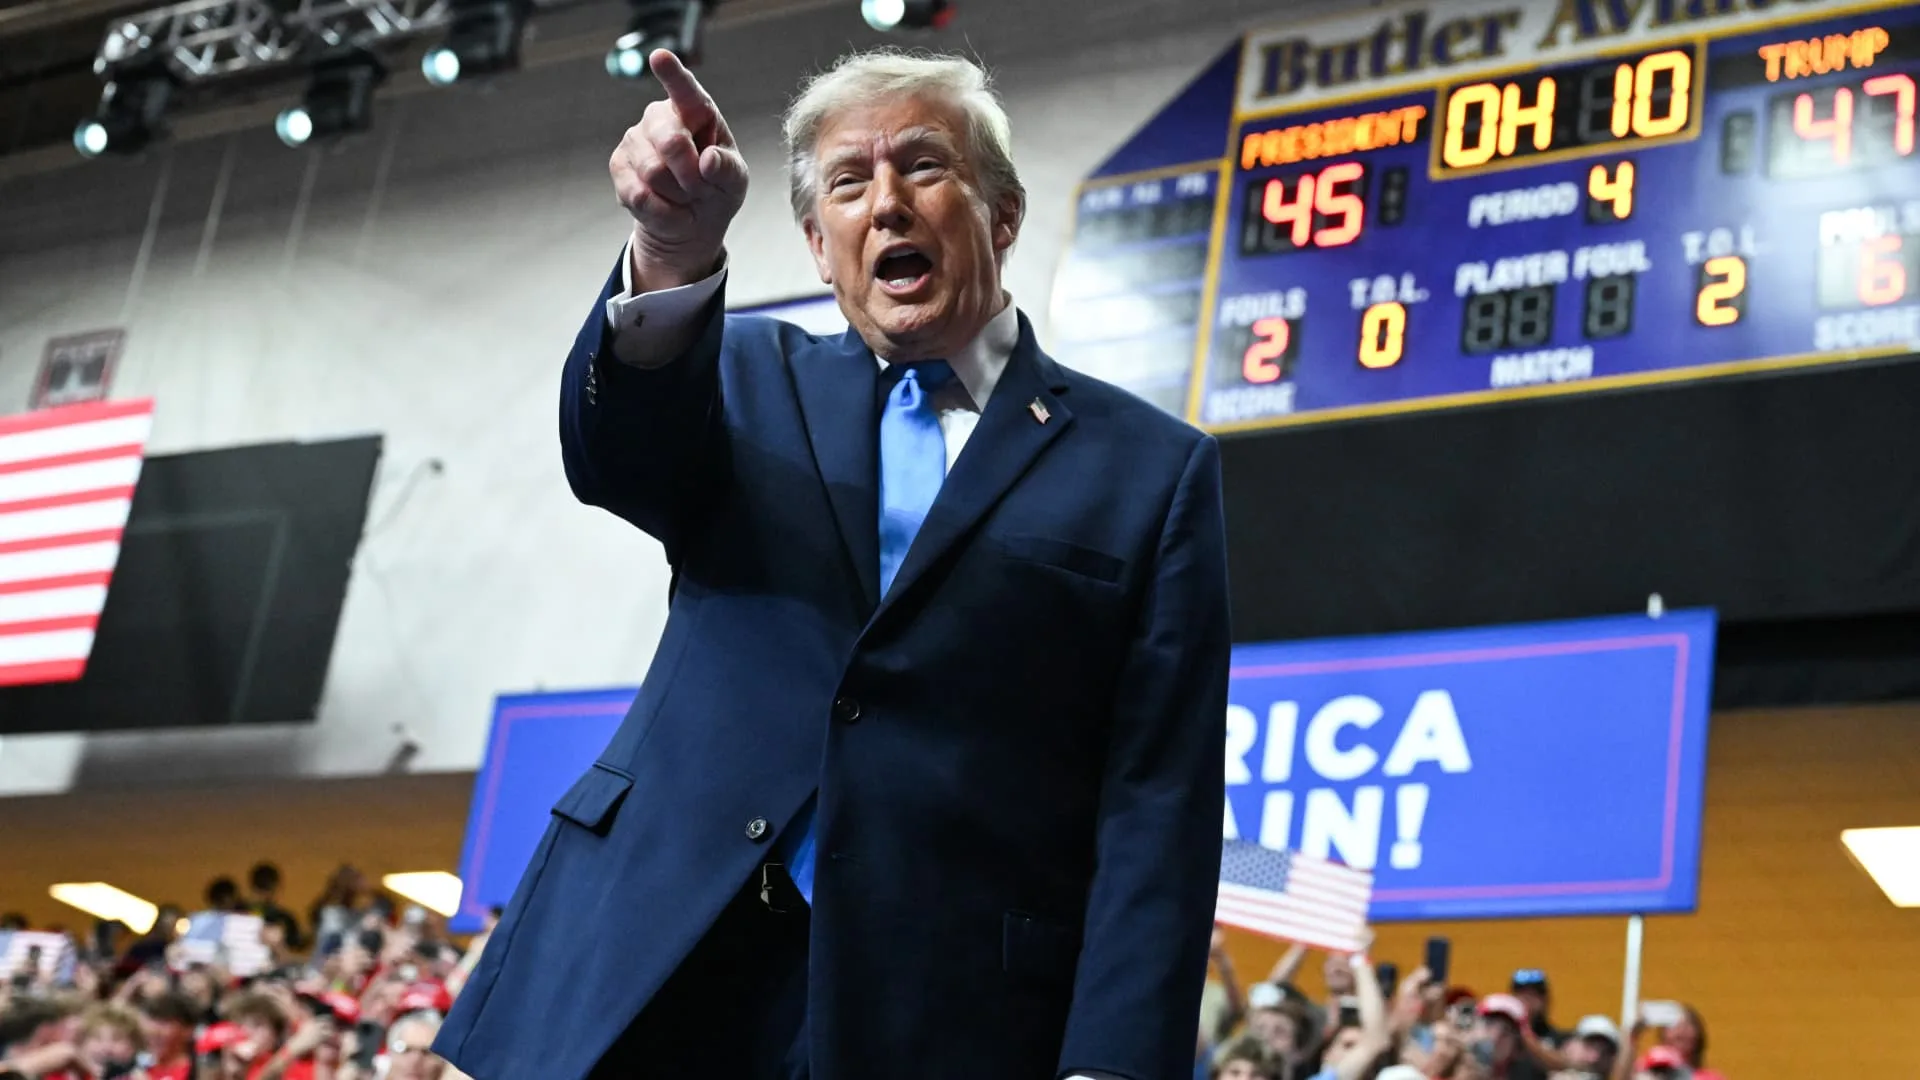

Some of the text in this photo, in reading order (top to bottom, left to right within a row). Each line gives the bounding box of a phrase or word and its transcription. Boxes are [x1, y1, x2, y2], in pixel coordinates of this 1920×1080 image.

[1257, 10, 1523, 99] Butler
[1758, 26, 1890, 82] TRUMP
[1611, 50, 1692, 138] 10
[1794, 73, 1917, 167] 47
[1241, 105, 1427, 170] PRESIDENT
[1263, 161, 1365, 248] 45
[1467, 181, 1579, 229] PERIOD
[1588, 160, 1634, 219] 4
[1454, 239, 1652, 297] PLAYER FOUL
[1696, 255, 1746, 327] 2
[1857, 233, 1906, 307] 6
[1219, 287, 1307, 329] FOULS
[1358, 300, 1407, 369] 0
[1243, 316, 1290, 384] 2
[1490, 345, 1594, 389] MATCH
[1223, 782, 1430, 870] IN!
